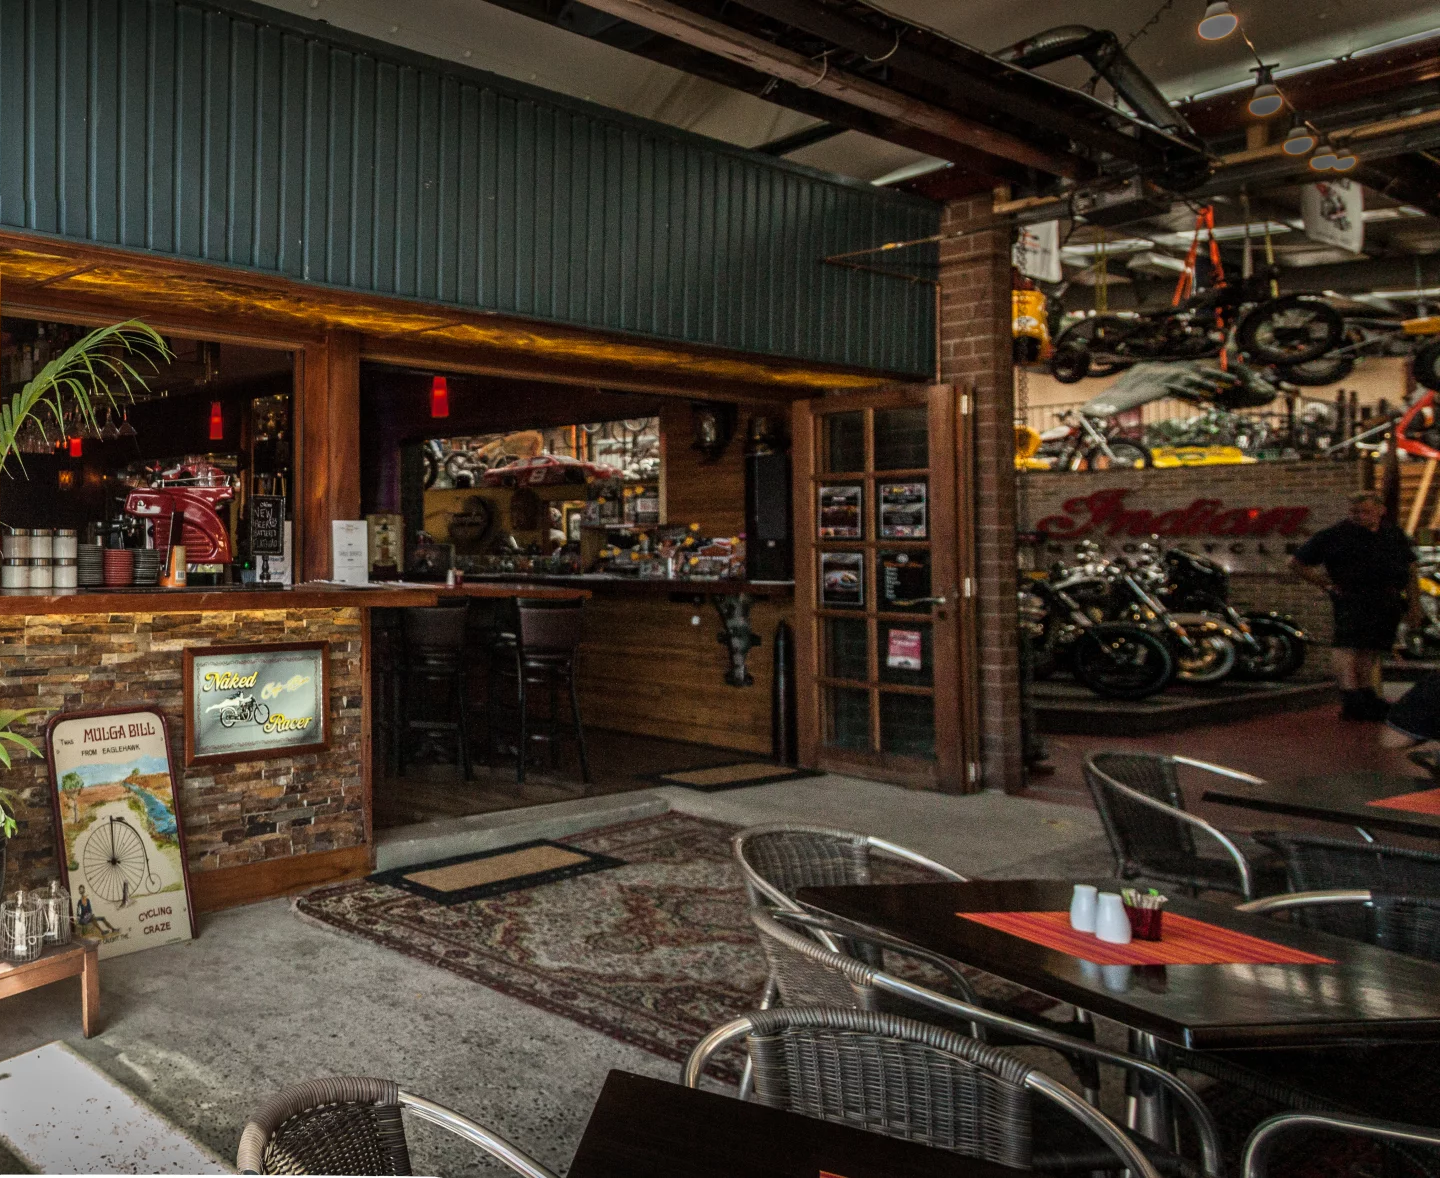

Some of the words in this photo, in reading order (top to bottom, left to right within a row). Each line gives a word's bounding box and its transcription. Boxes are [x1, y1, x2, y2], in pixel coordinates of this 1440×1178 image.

[1036, 488, 1310, 537] Indian
[203, 671, 258, 692] Naked
[83, 725, 126, 743] MULGA
[128, 722, 156, 737] BILL
[263, 713, 312, 733] Racer
[102, 744, 141, 754] EAGLEHAWK
[138, 906, 172, 922] CYCLING
[143, 922, 171, 935] CRAZE
